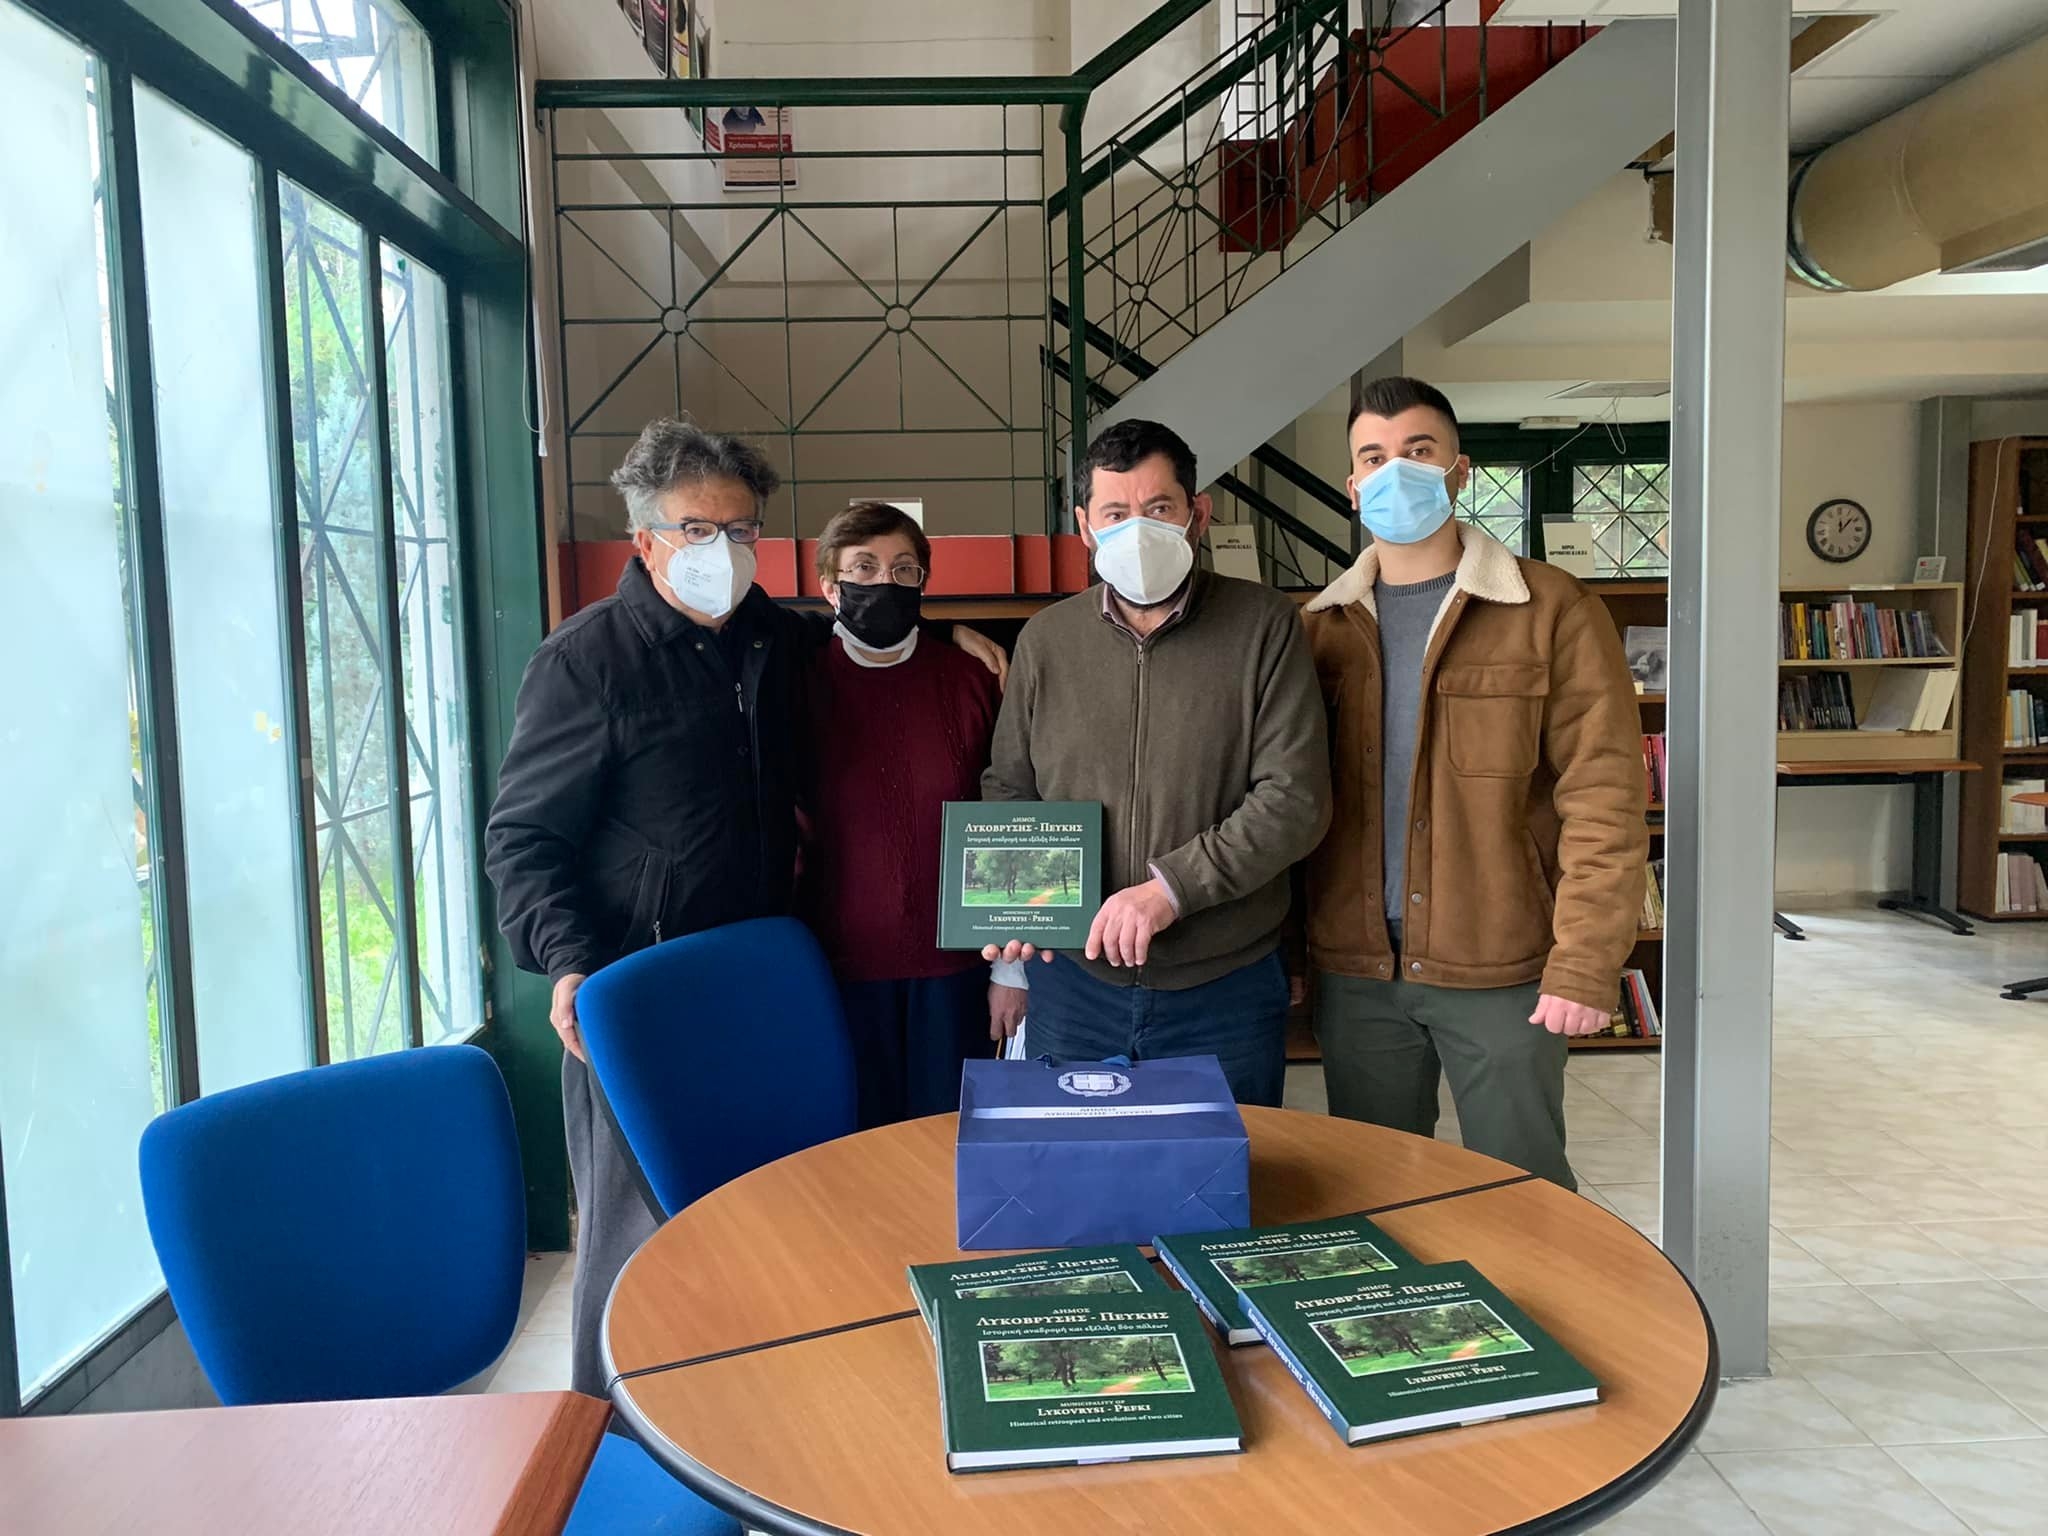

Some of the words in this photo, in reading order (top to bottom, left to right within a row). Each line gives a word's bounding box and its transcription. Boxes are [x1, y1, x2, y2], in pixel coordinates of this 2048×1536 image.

[965, 823, 1033, 833] ΛΥΚΟΒΡΥΣΗΣ
[1040, 822, 1084, 832] ΠΕΥΚΗΣ
[950, 1265, 1048, 1281] ΛΥΚΟΒΡΥΣΗΣ
[1057, 1257, 1119, 1269] ΠΕΥΚΗΣ
[1357, 1283, 1392, 1292] ΔΗΜΟΣ
[1295, 1290, 1394, 1310] ΛΥΚΟΒΡΥΣΗΣ
[1400, 1281, 1466, 1295] ΠΕΥΚΗΣ
[976, 1314, 1087, 1326] ΛΥΚΟΒΡΥΣΗΣ
[1100, 1312, 1169, 1322] ΠΕΥΚΗΣ
[1037, 1407, 1105, 1417] LYKOVRYSI
[1114, 1404, 1151, 1412] PEFKI
